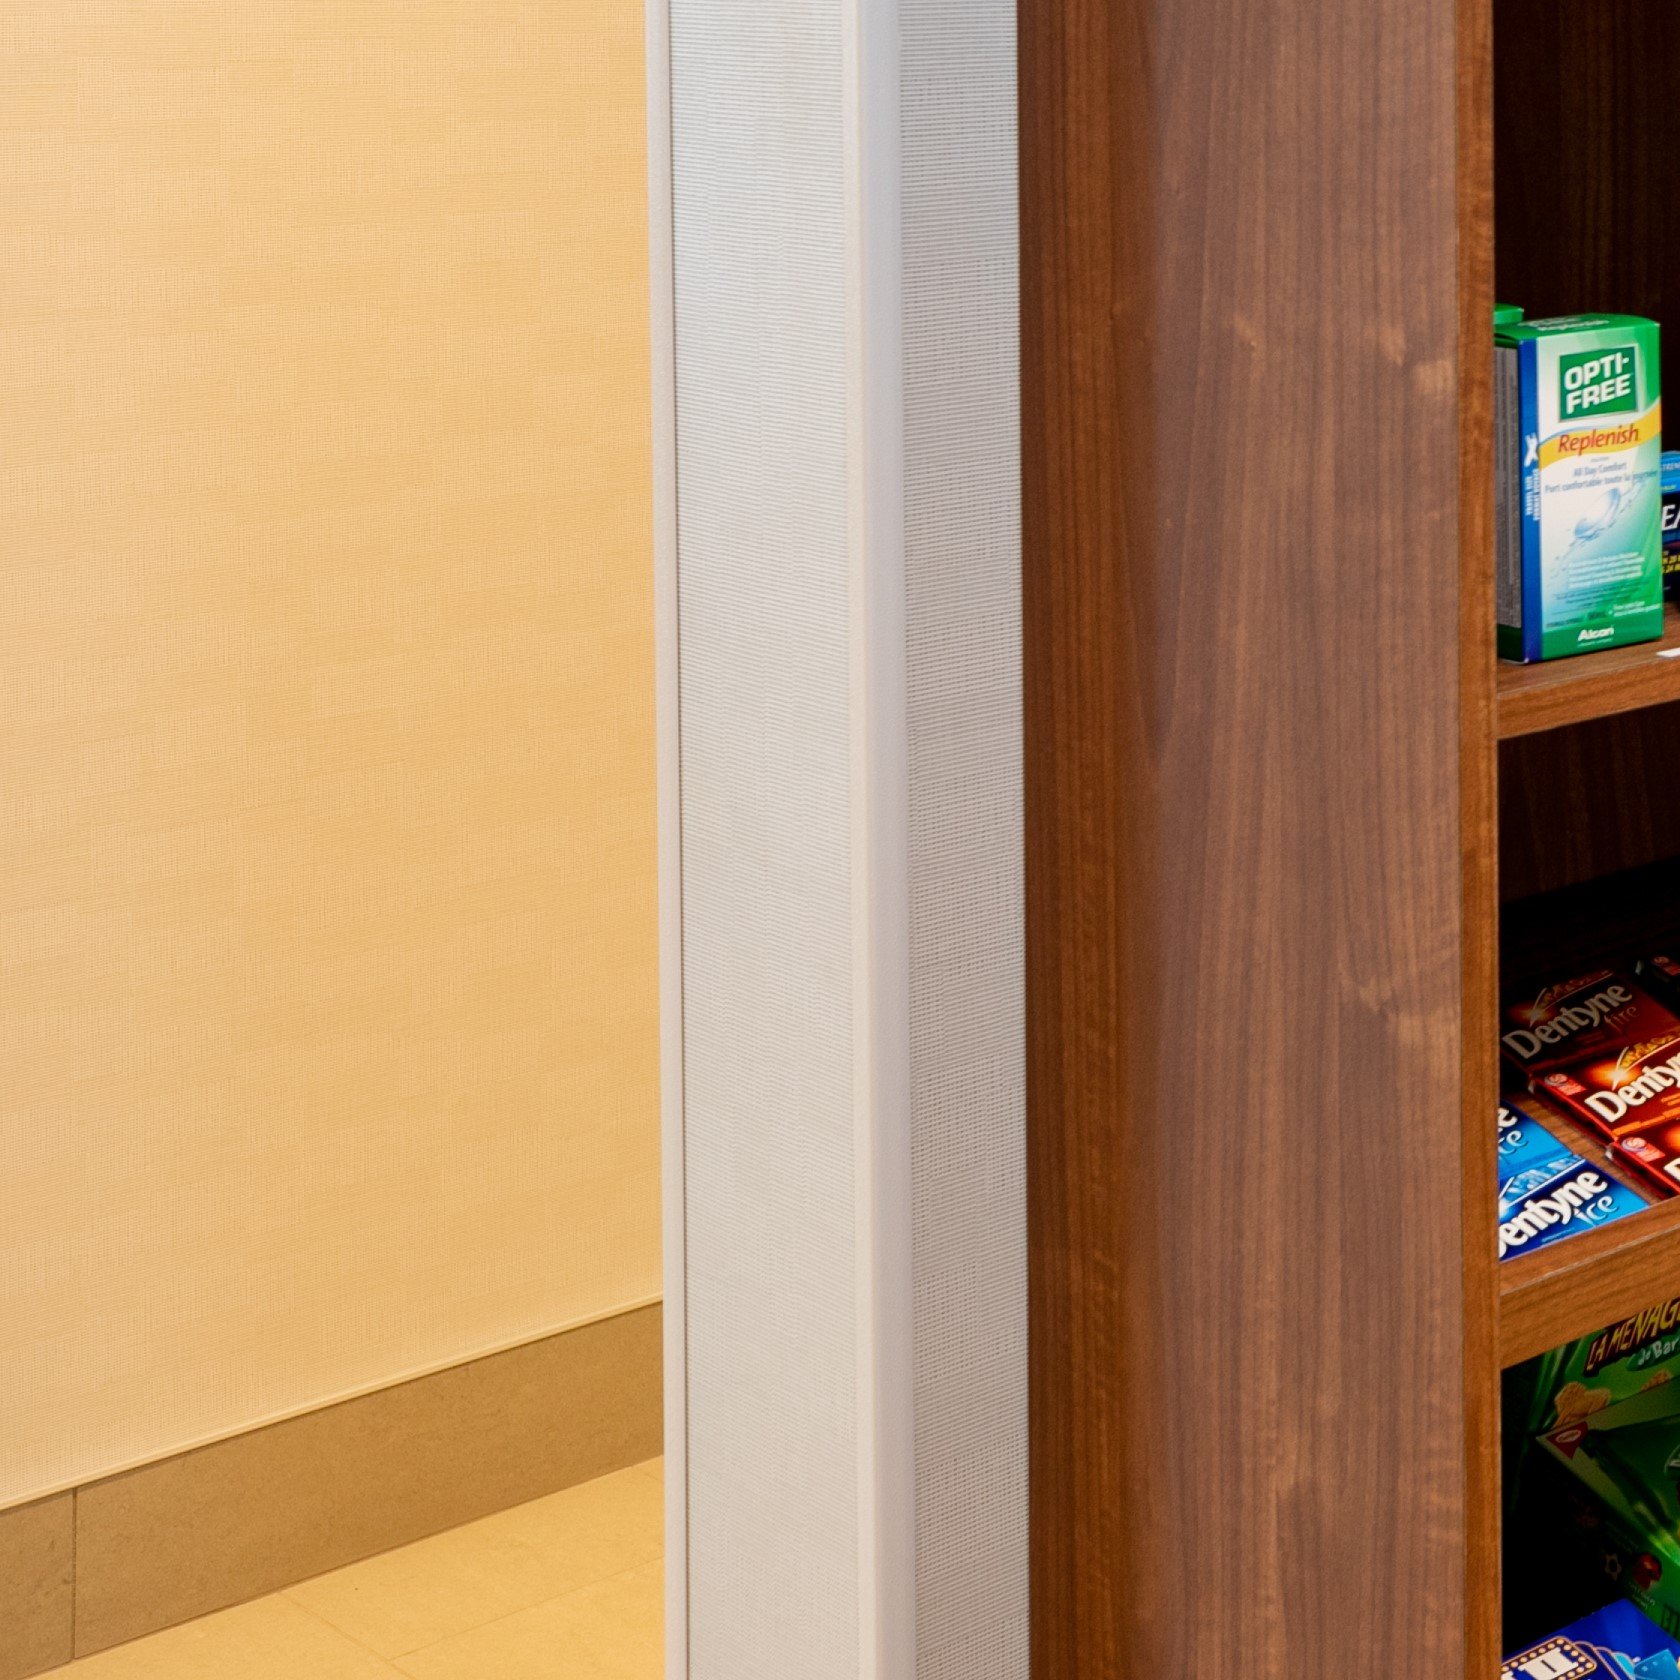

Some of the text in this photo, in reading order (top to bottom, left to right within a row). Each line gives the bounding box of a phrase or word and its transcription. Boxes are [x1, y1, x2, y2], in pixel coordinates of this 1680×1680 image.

[1564, 352, 1630, 392] OPTI-
[1566, 373, 1631, 414] FREE
[1558, 423, 1639, 457] Replenish
[1578, 625, 1614, 642] Alcon
[1502, 983, 1634, 1061] Dentyne
[1604, 1003, 1642, 1036] fire
[1574, 1191, 1620, 1229] ice
